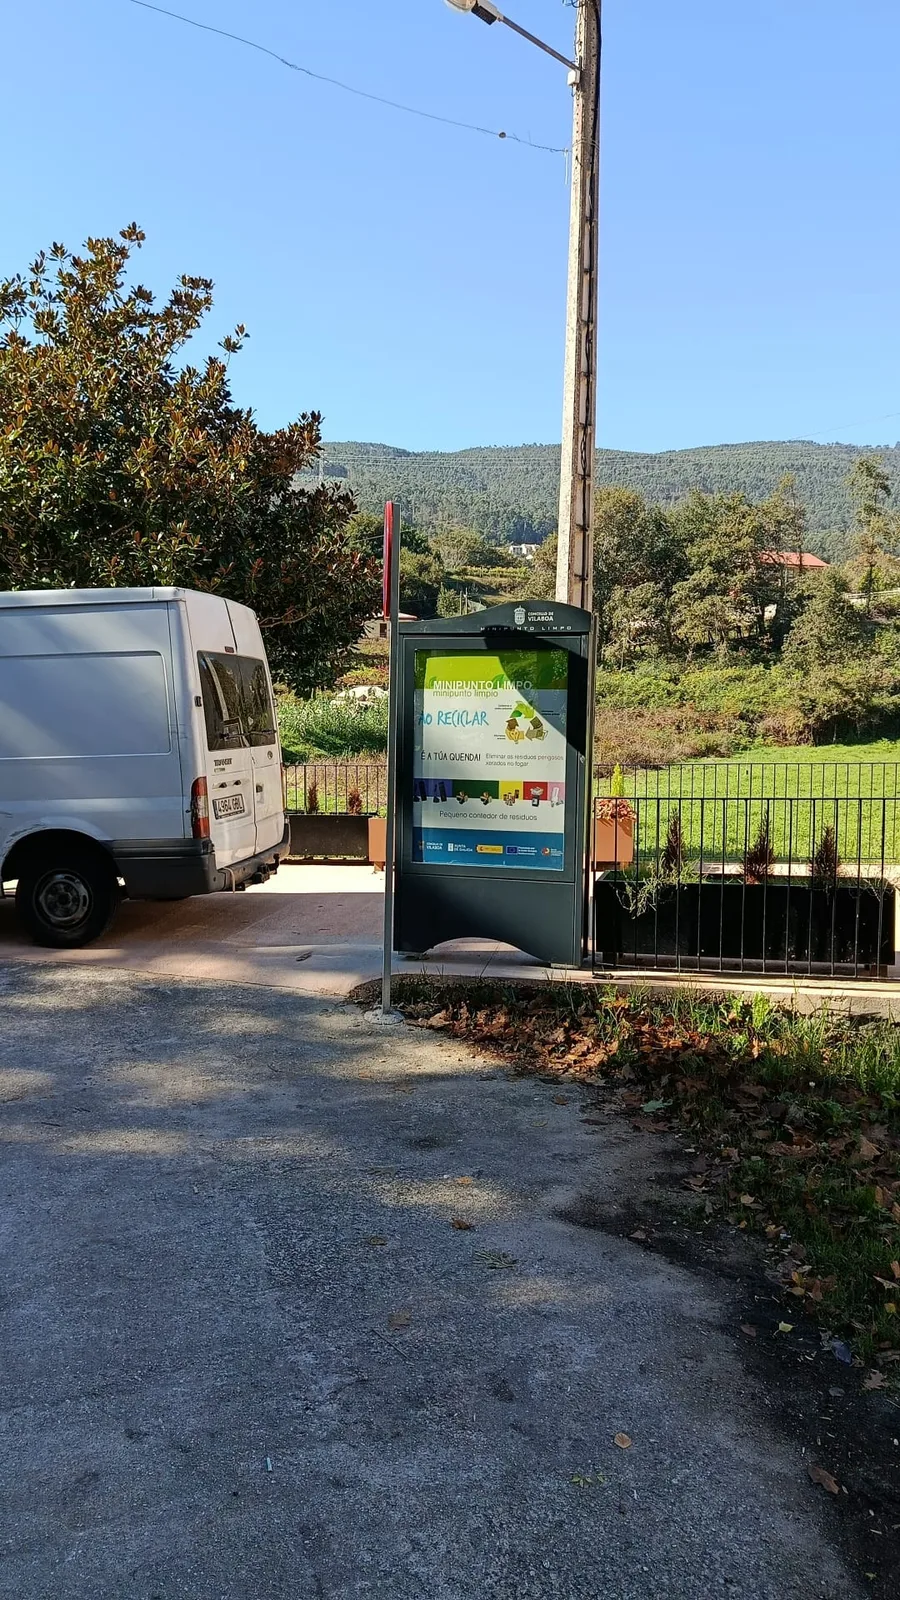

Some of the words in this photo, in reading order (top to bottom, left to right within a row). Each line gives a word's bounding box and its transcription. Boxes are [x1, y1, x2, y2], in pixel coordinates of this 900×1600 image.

[433, 680, 494, 690] MINIPUNTO
[496, 681, 533, 690] LIMPO
[432, 690, 473, 698] minipunto
[474, 690, 499, 698] limpio
[437, 709, 489, 727] RECICLAR
[420, 749, 426, 760] É
[427, 752, 432, 761] A
[433, 750, 448, 761] TÚA
[485, 752, 506, 760] Eliminar
[217, 798, 231, 813] 4964
[468, 812, 498, 820] contedor
[509, 813, 538, 821] residuos
